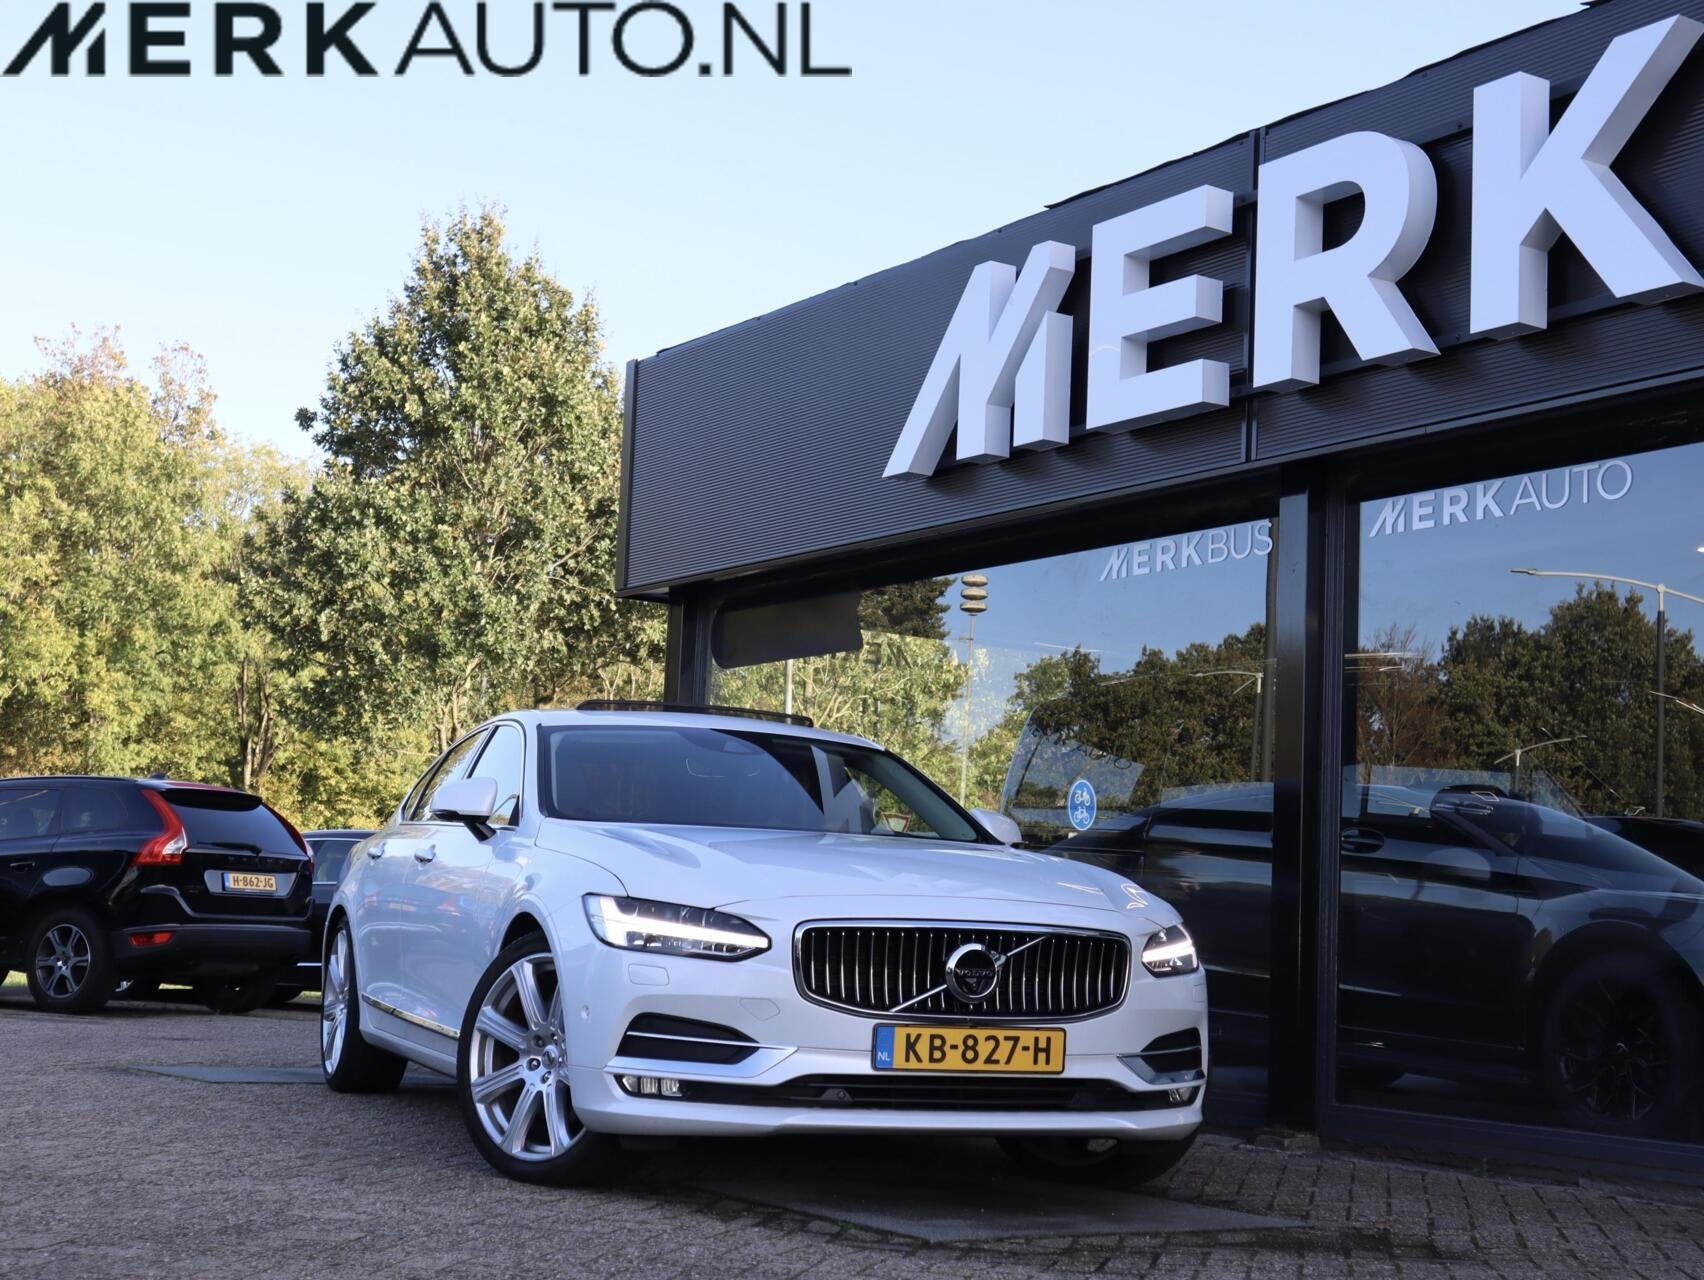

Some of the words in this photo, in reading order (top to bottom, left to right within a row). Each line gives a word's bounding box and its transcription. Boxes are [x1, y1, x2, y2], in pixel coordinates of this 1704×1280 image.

[882, 14, 1704, 479] MERK
[1369, 459, 1633, 538] MERKAUTO
[1099, 521, 1274, 582] MERKBUS
[232, 875, 274, 889] H-862-JG
[877, 1051, 891, 1061] NL
[904, 1033, 1052, 1066] KB-827-H
